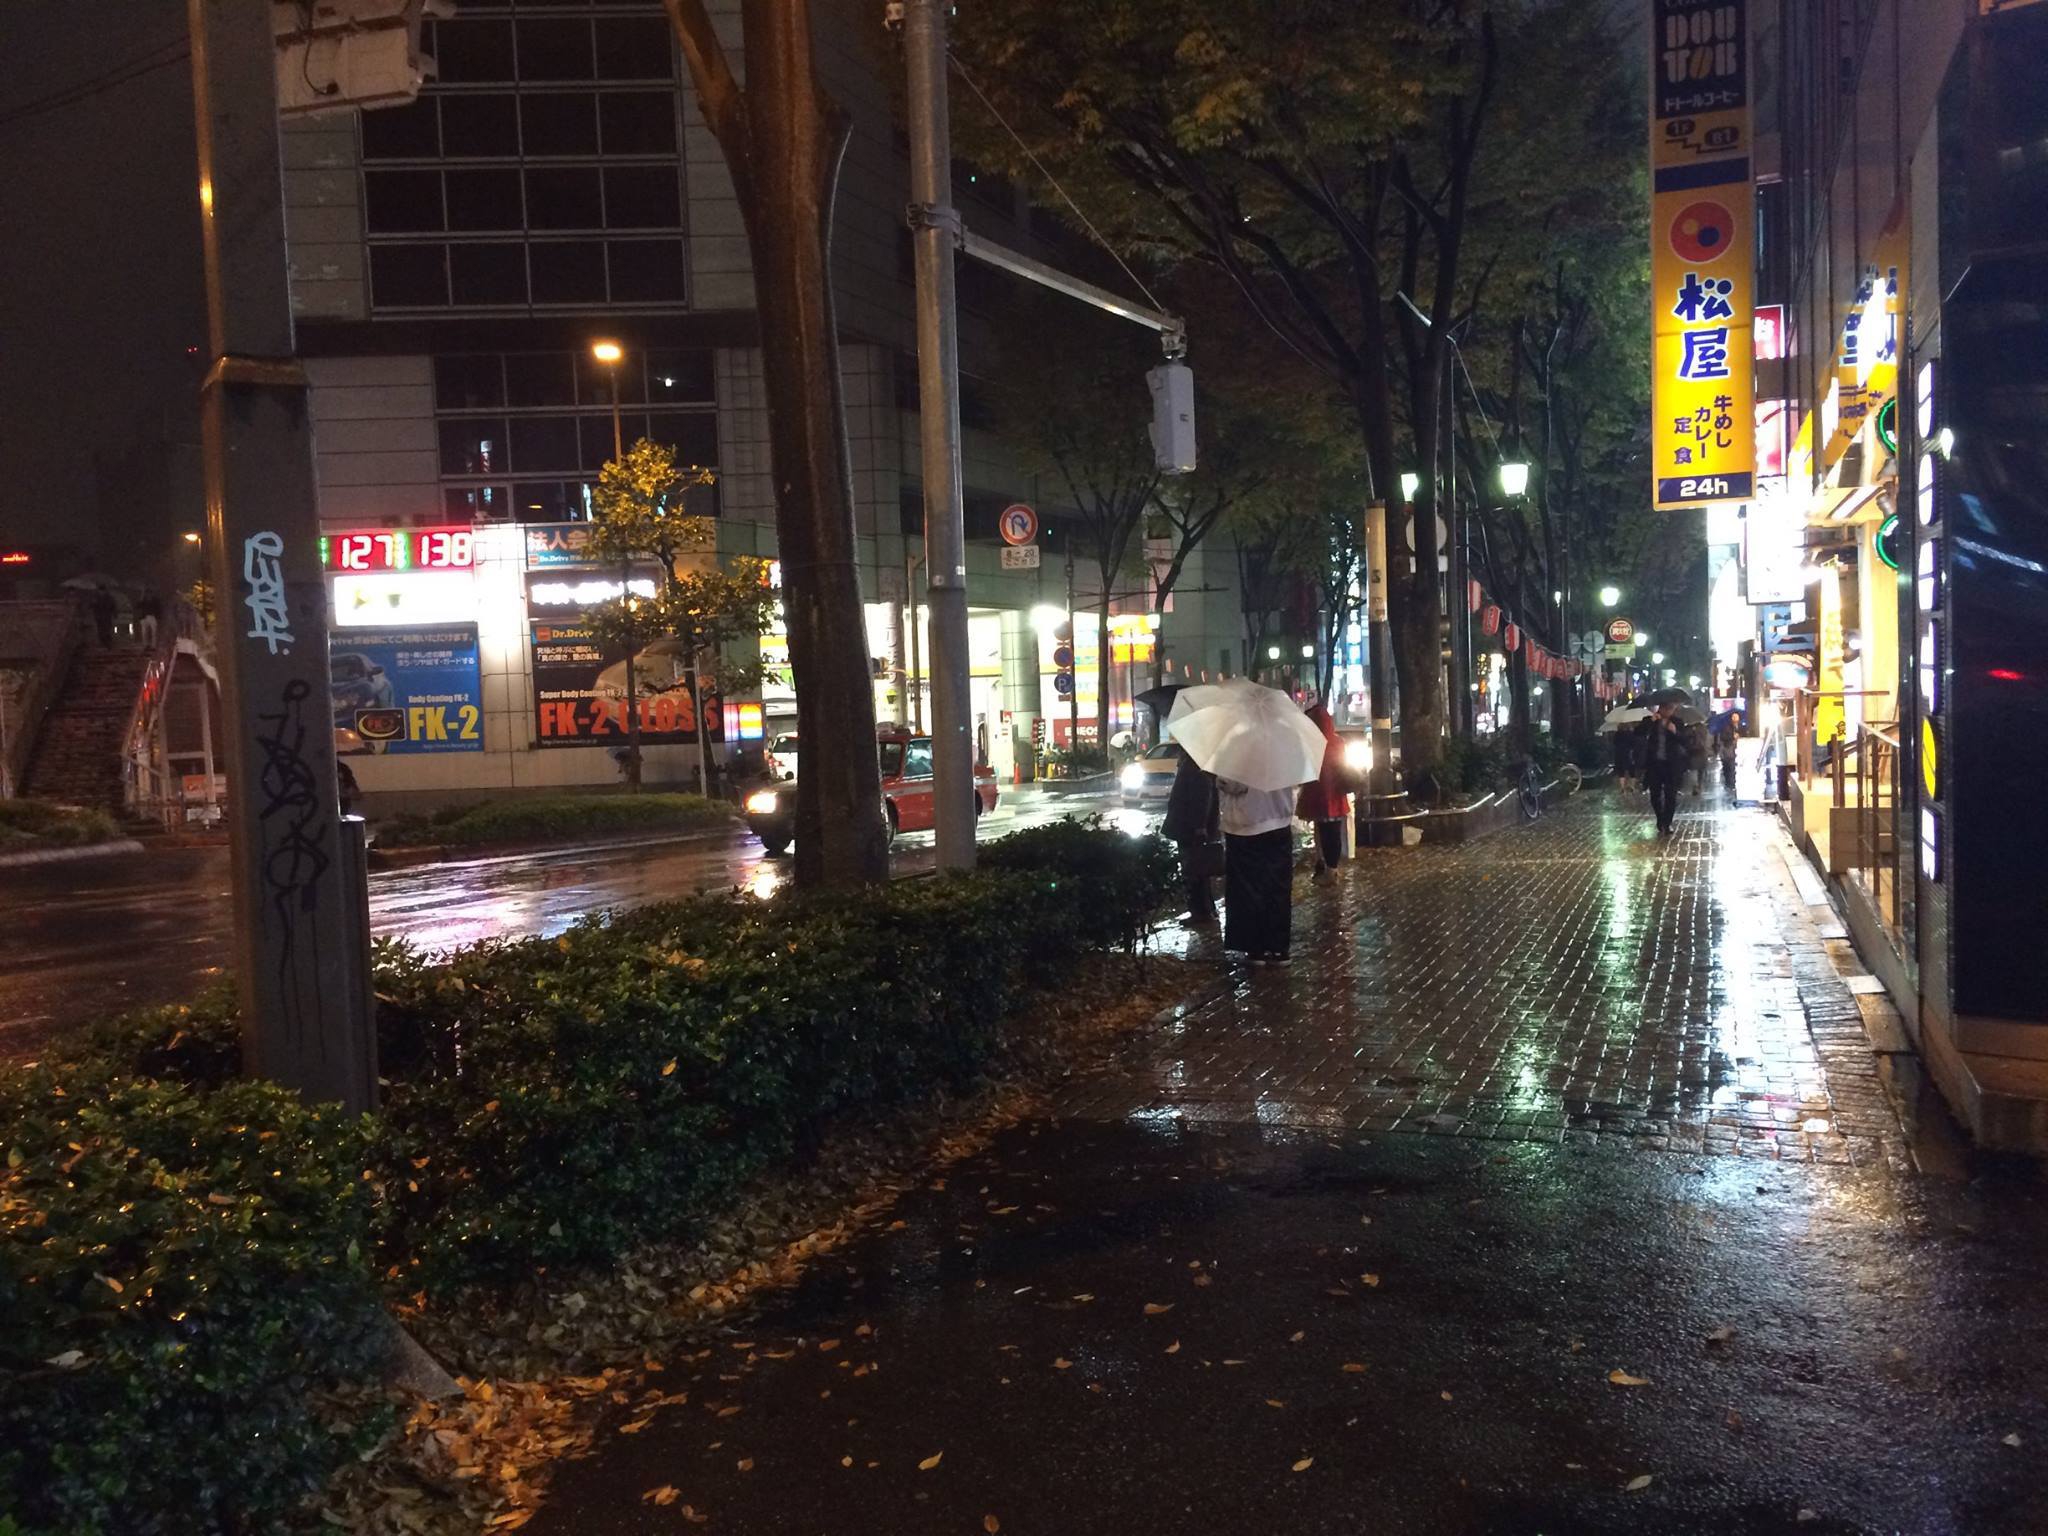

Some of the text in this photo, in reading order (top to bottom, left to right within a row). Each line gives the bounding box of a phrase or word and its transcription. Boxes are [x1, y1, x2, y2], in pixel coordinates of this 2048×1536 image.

[1665, 91, 1739, 112] ドトールコーヒー
[1671, 272, 1735, 379] 松屋
[1695, 406, 1712, 459] カレー
[1714, 394, 1733, 448] 牛めし
[1674, 417, 1692, 464] 定食
[1680, 477, 1728, 497] 24h
[421, 531, 473, 567] 138
[562, 689, 579, 699] Body
[408, 705, 479, 741] FK-2
[540, 701, 610, 737] FK-2
